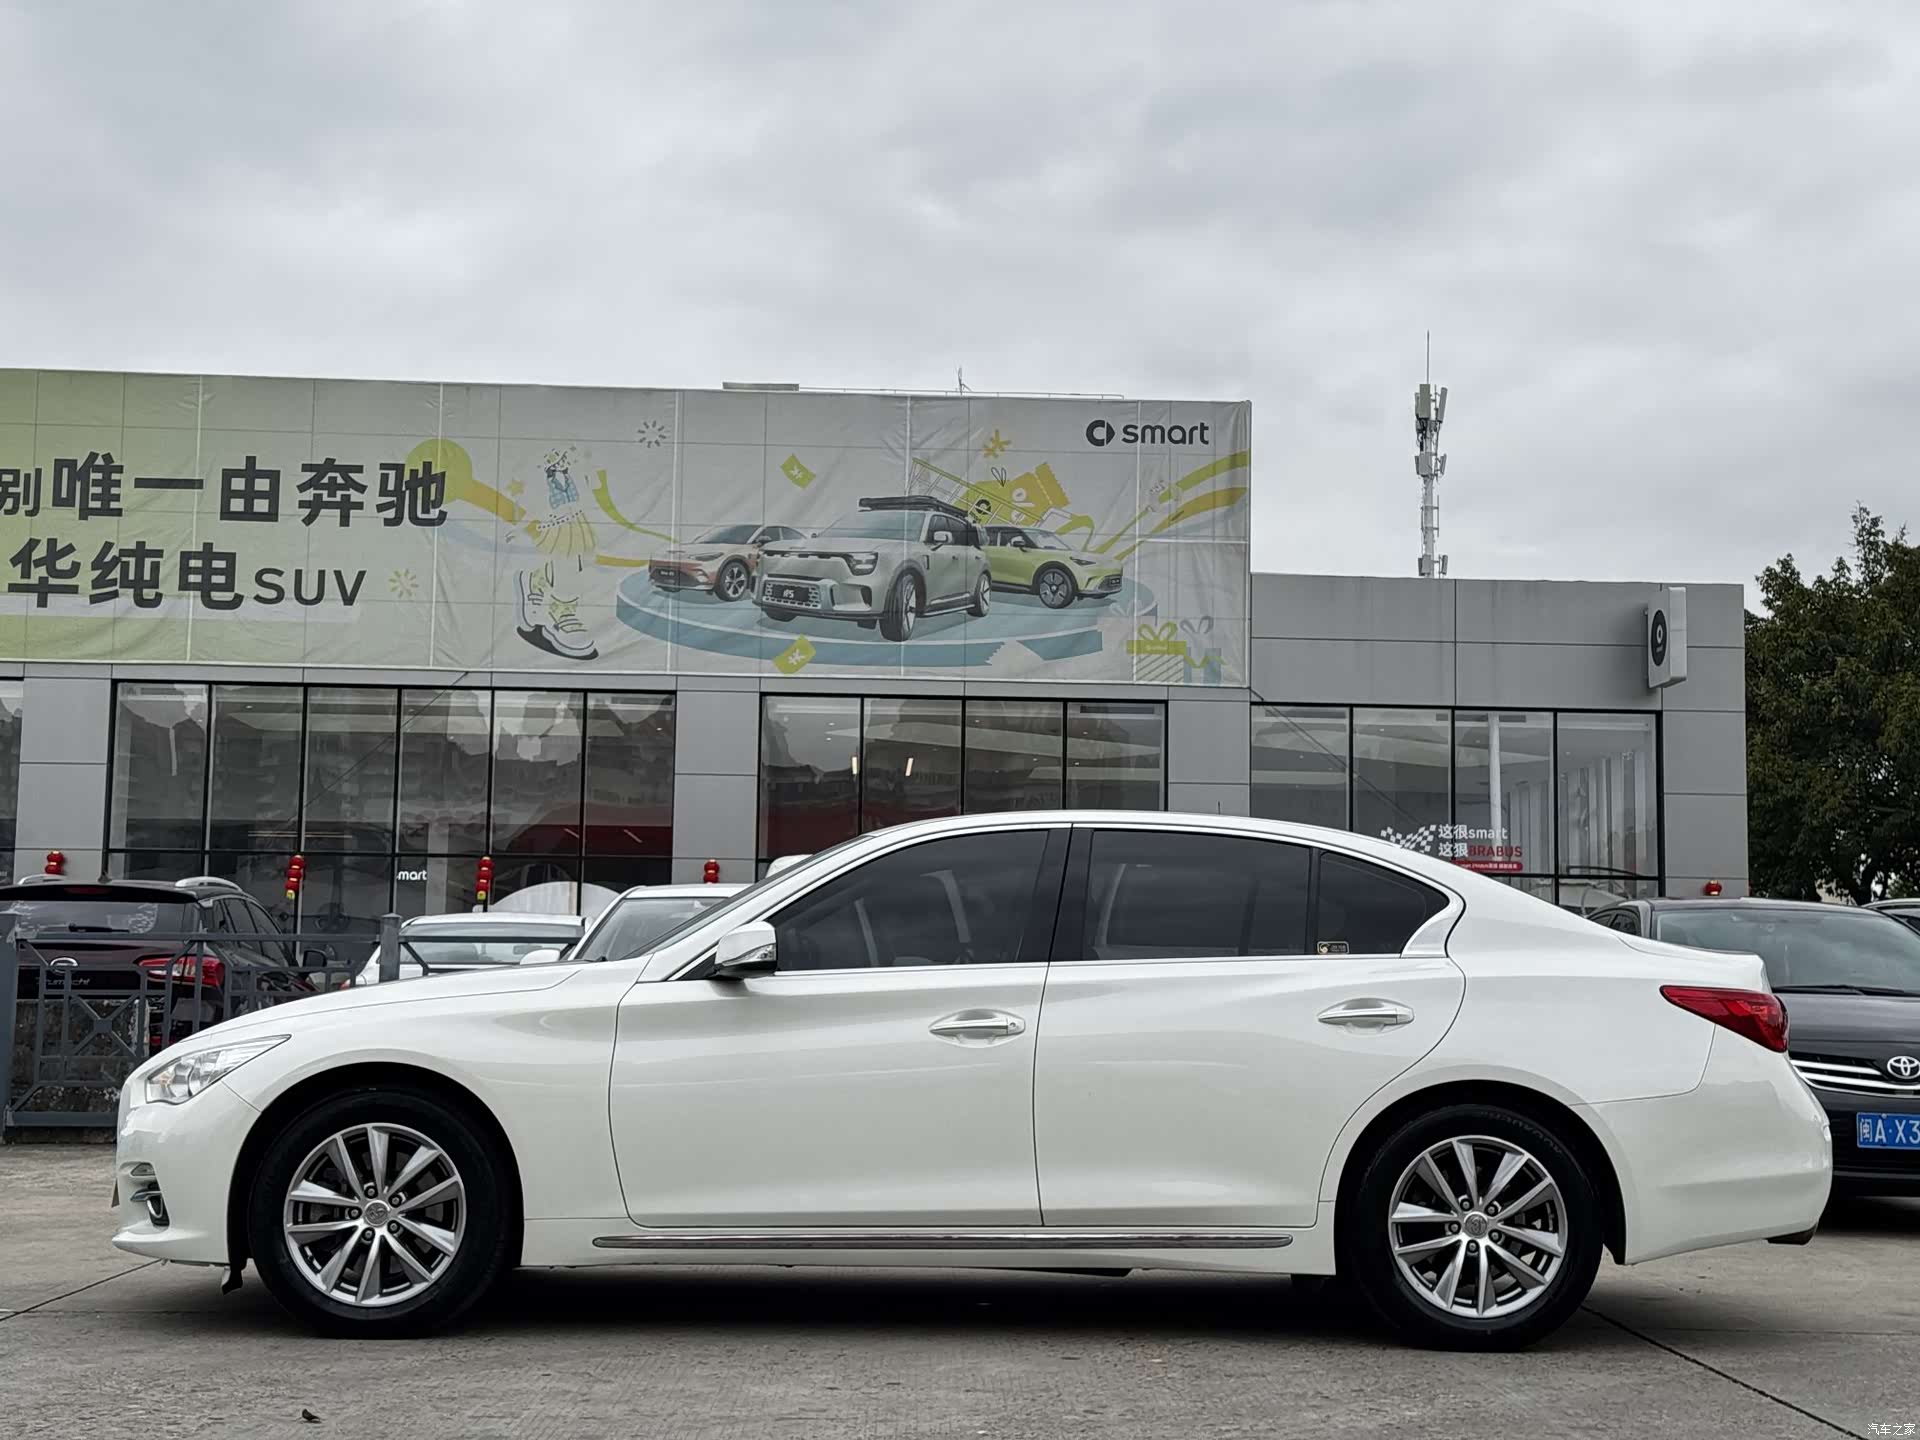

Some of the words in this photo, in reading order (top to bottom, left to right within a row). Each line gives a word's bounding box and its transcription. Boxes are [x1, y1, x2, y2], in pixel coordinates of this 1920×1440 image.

[1121, 422, 1209, 445] smart
[0, 451, 447, 527] 别唯一由奔驰
[8, 537, 366, 610] 华纯电SUV
[395, 870, 427, 880] mart
